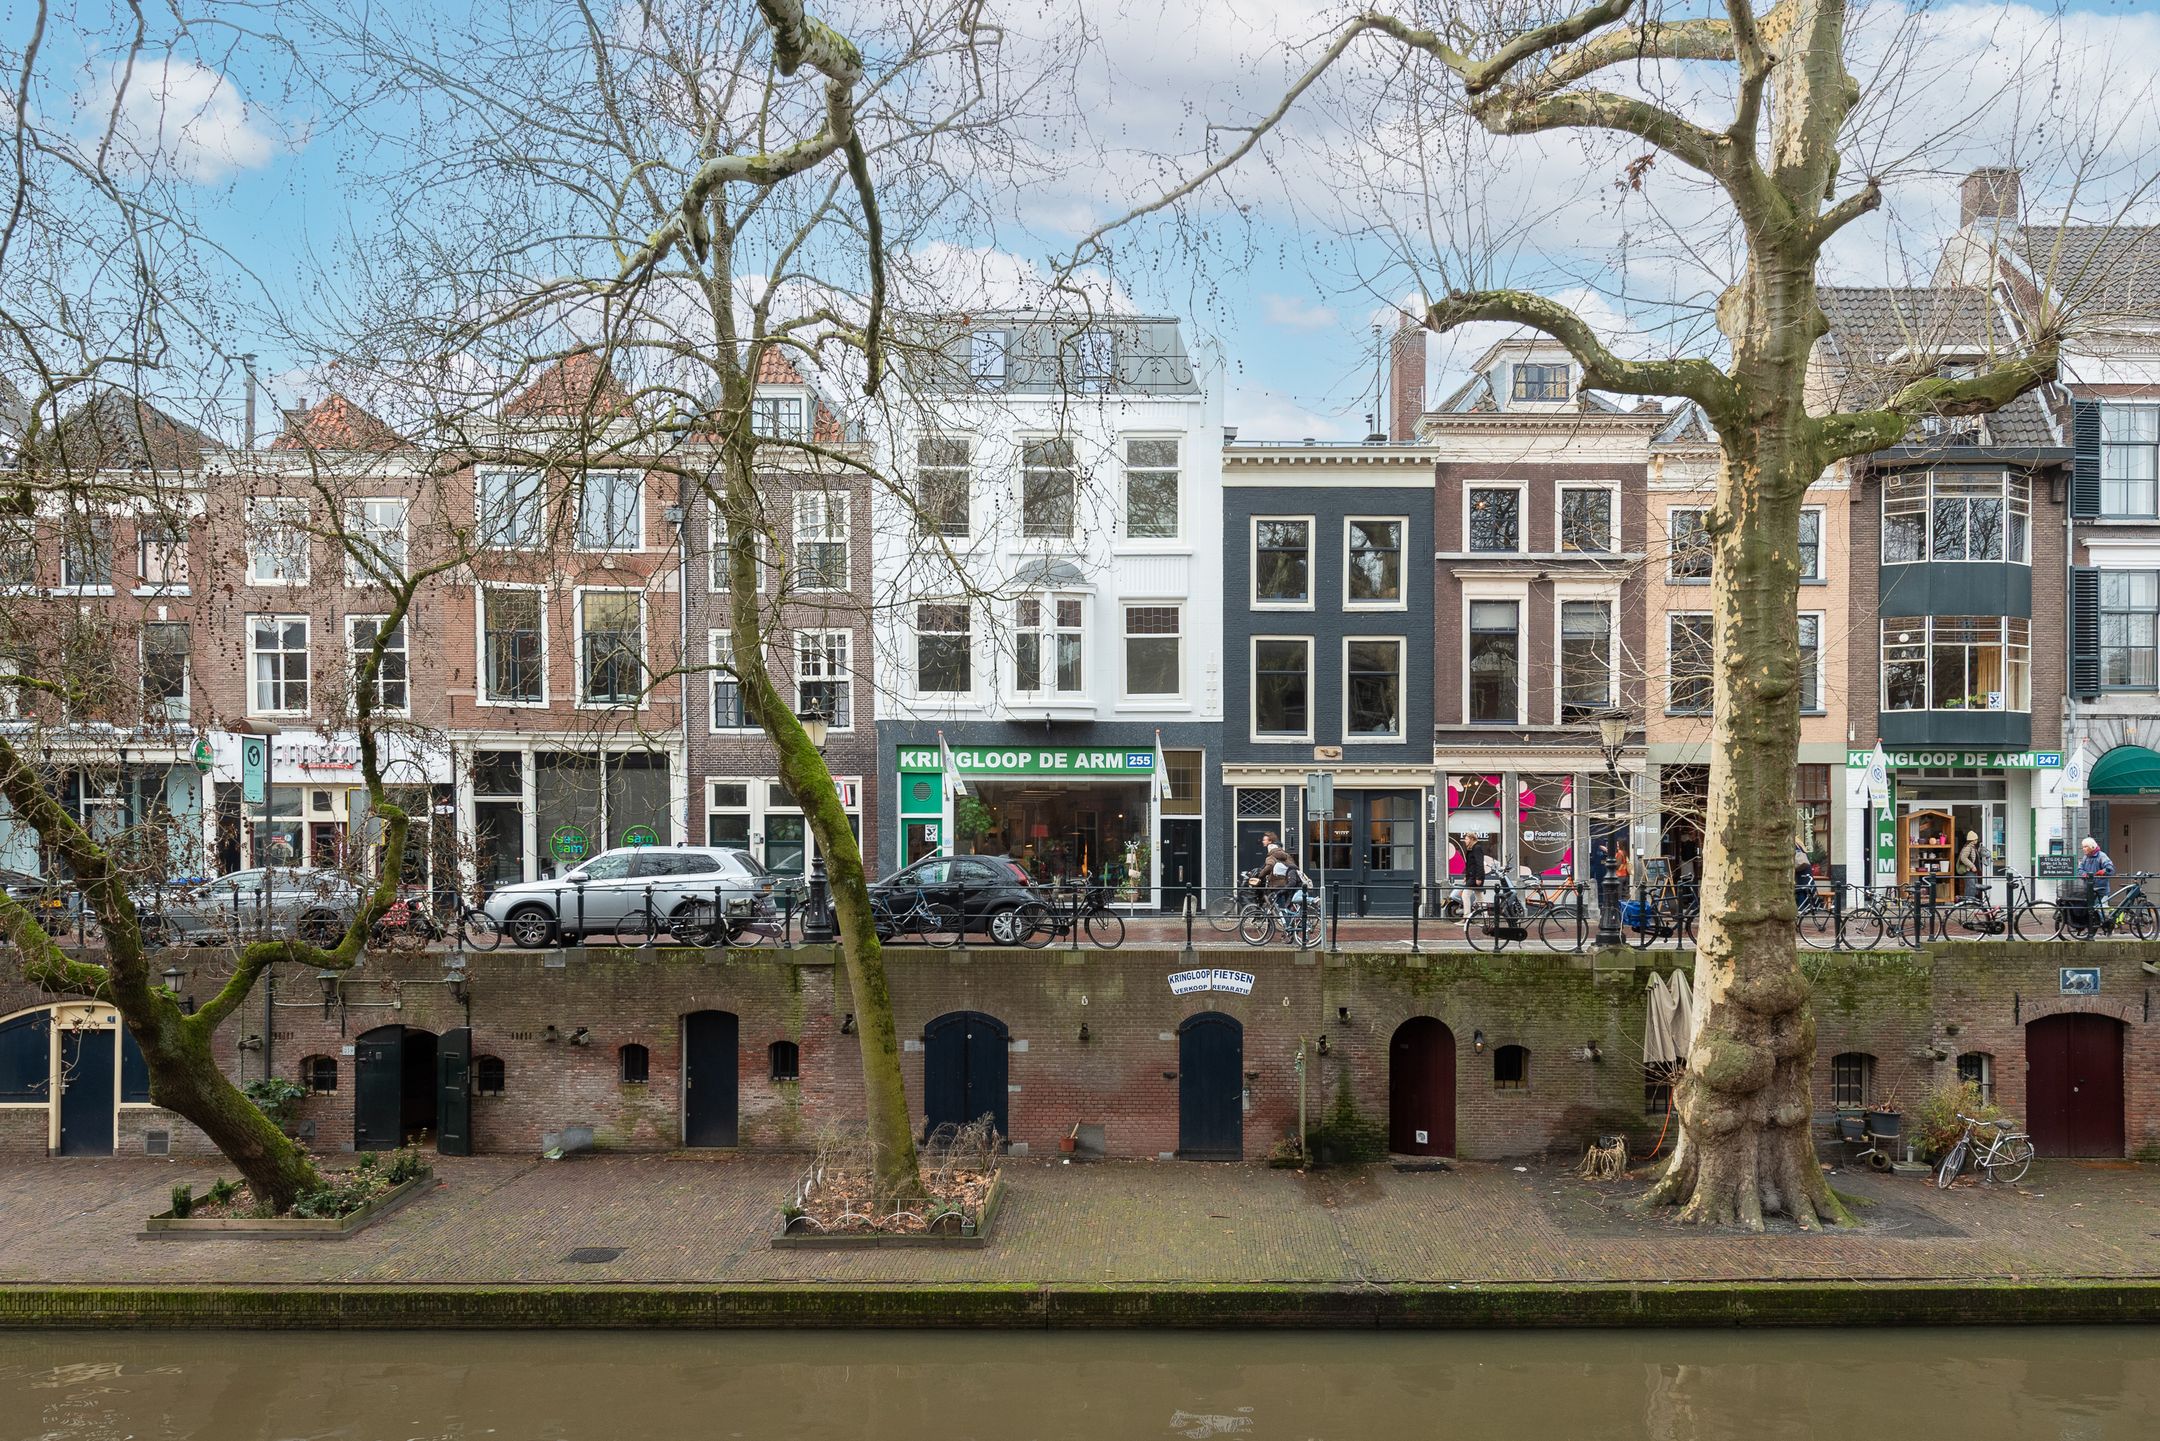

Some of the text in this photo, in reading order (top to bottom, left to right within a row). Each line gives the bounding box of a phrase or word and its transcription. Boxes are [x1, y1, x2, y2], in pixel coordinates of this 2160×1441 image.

[1039, 752, 1068, 768] DE
[1074, 752, 1123, 768] ARM
[1128, 755, 1151, 765] 255
[1849, 752, 2034, 766] KRNGLOOP DE ARM
[2039, 756, 2058, 764] 247
[556, 834, 583, 844] sam
[626, 834, 654, 843] sam
[556, 844, 583, 854] sam
[1169, 970, 1253, 984] KRINGLOOP FIETSEN
[1174, 984, 1250, 994] VERKOOP REPARATIE
